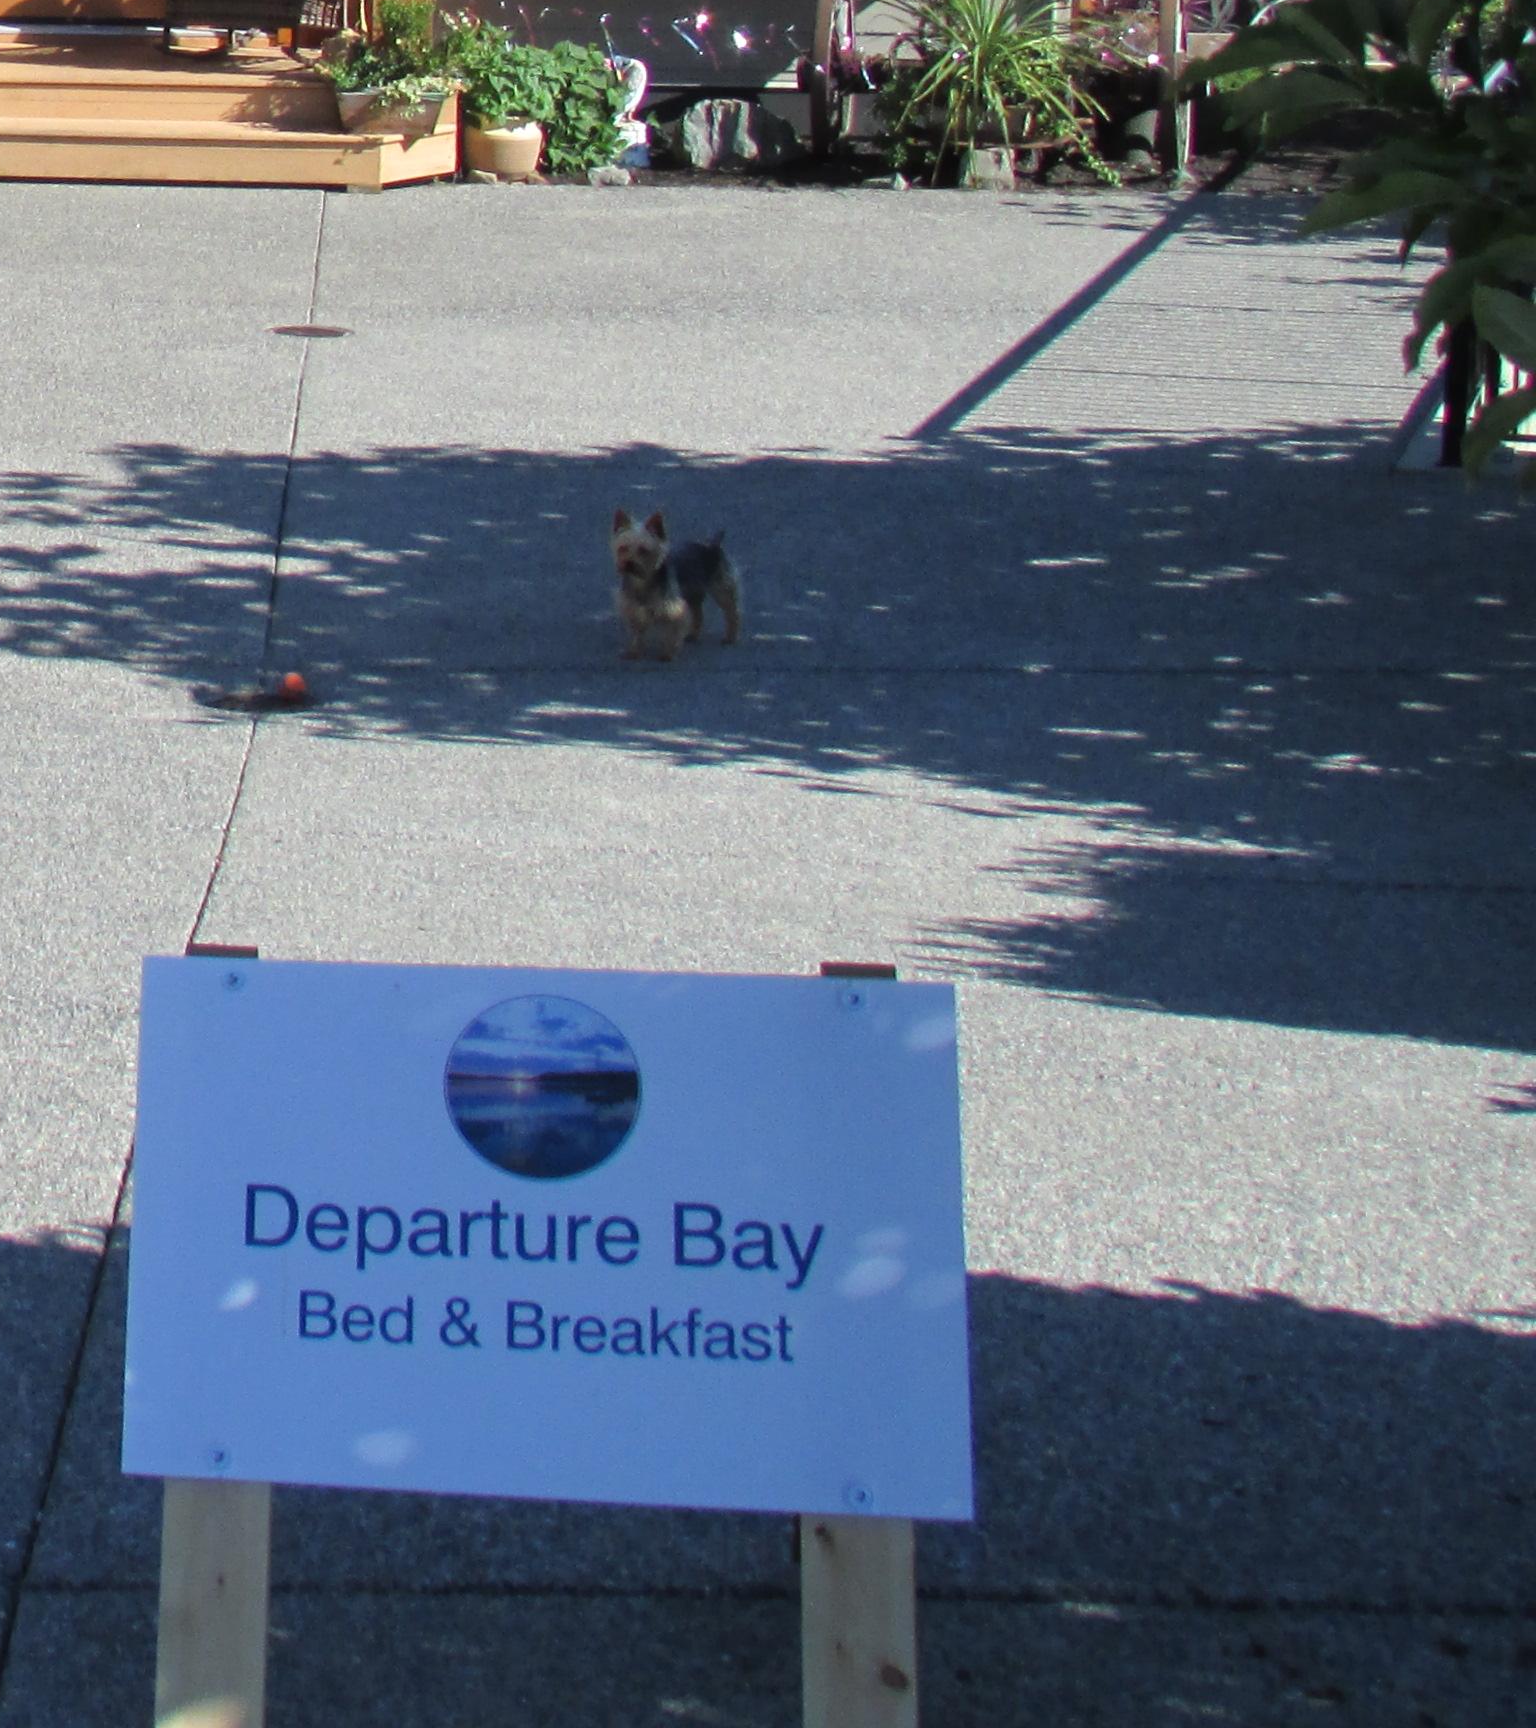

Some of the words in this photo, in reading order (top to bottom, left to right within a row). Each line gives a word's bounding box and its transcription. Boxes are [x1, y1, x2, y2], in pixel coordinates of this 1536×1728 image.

[244, 1183, 641, 1271] Departure
[672, 1201, 825, 1290] Bay
[298, 1288, 415, 1345] Bed
[438, 1295, 482, 1349] &
[505, 1299, 795, 1363] Breakfast
